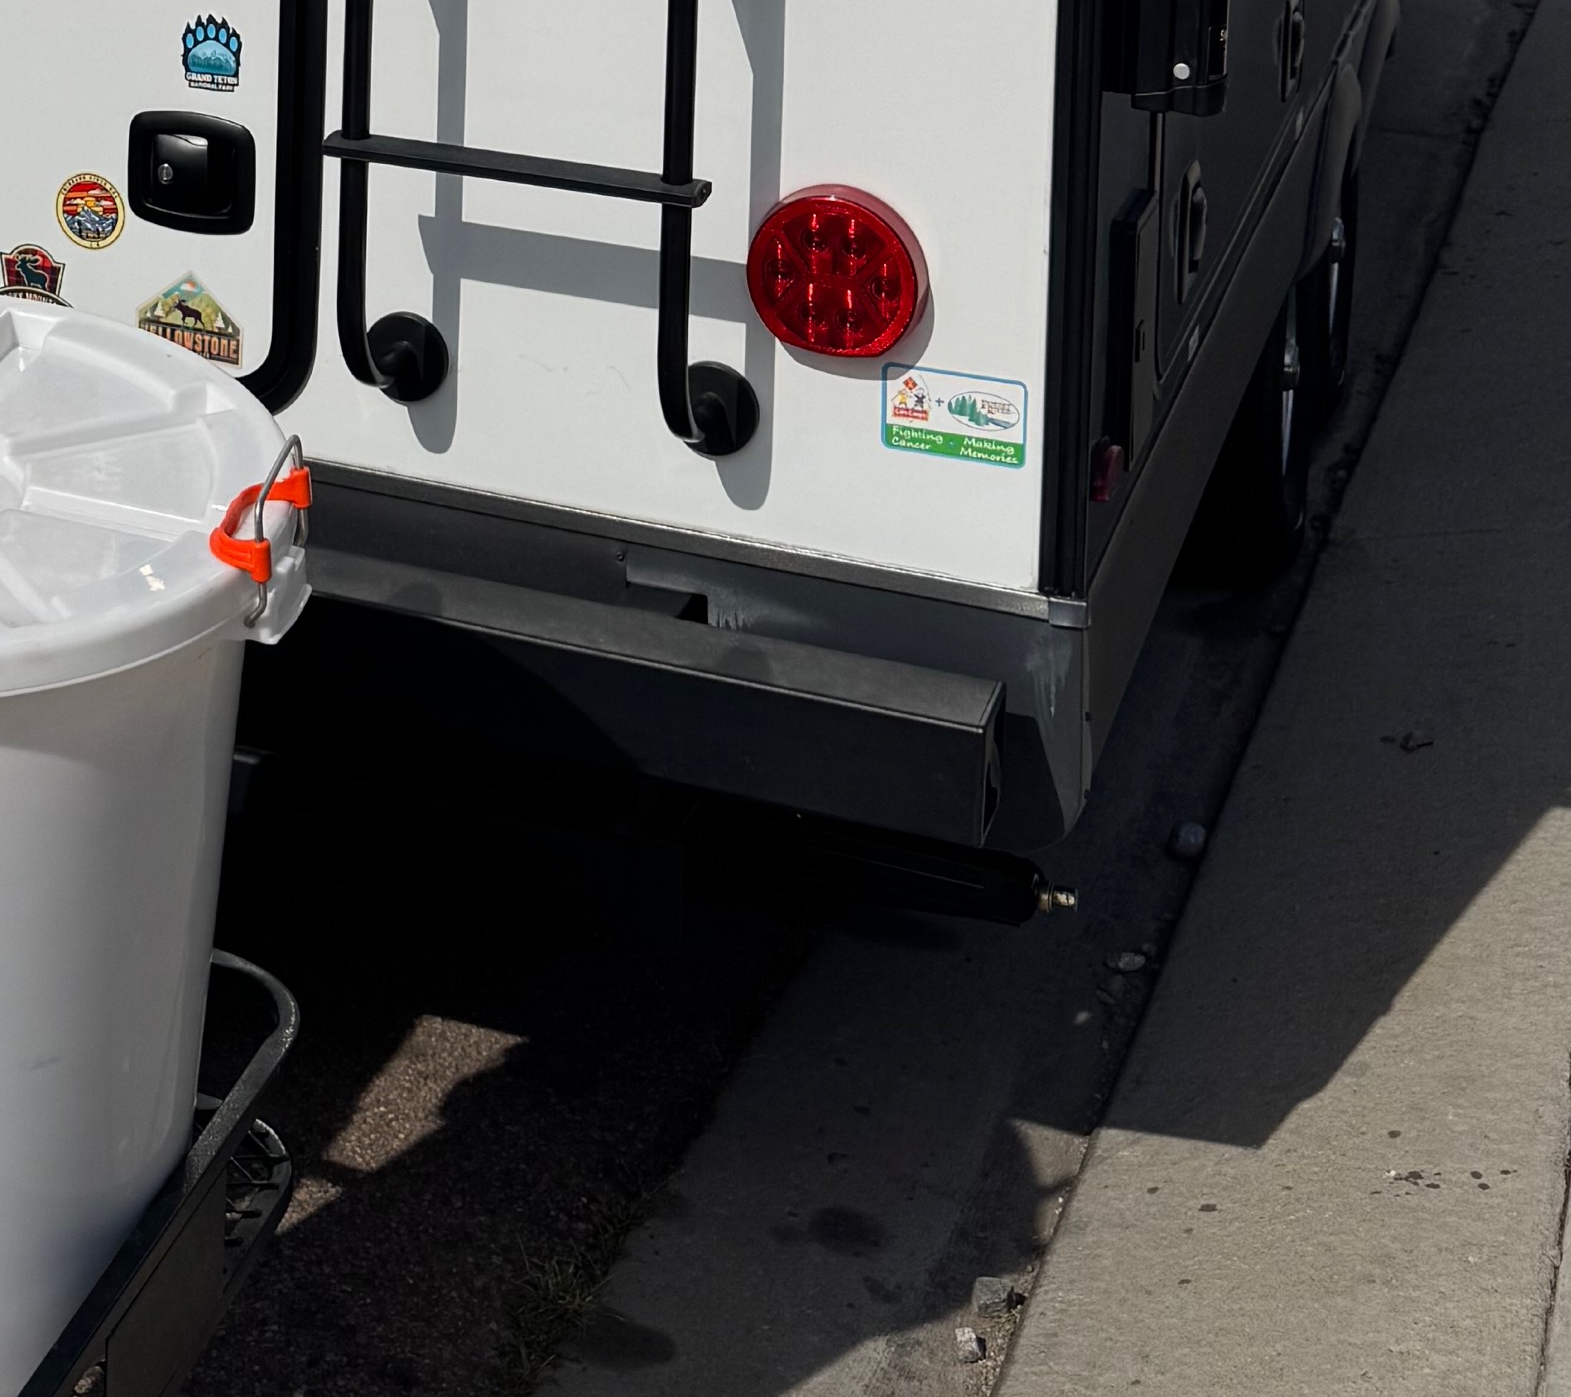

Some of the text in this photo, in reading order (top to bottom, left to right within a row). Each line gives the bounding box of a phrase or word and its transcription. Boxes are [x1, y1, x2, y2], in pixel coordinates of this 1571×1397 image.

[891, 437, 1018, 464] Cancer Memories
[892, 425, 1015, 455] Fighting Making
